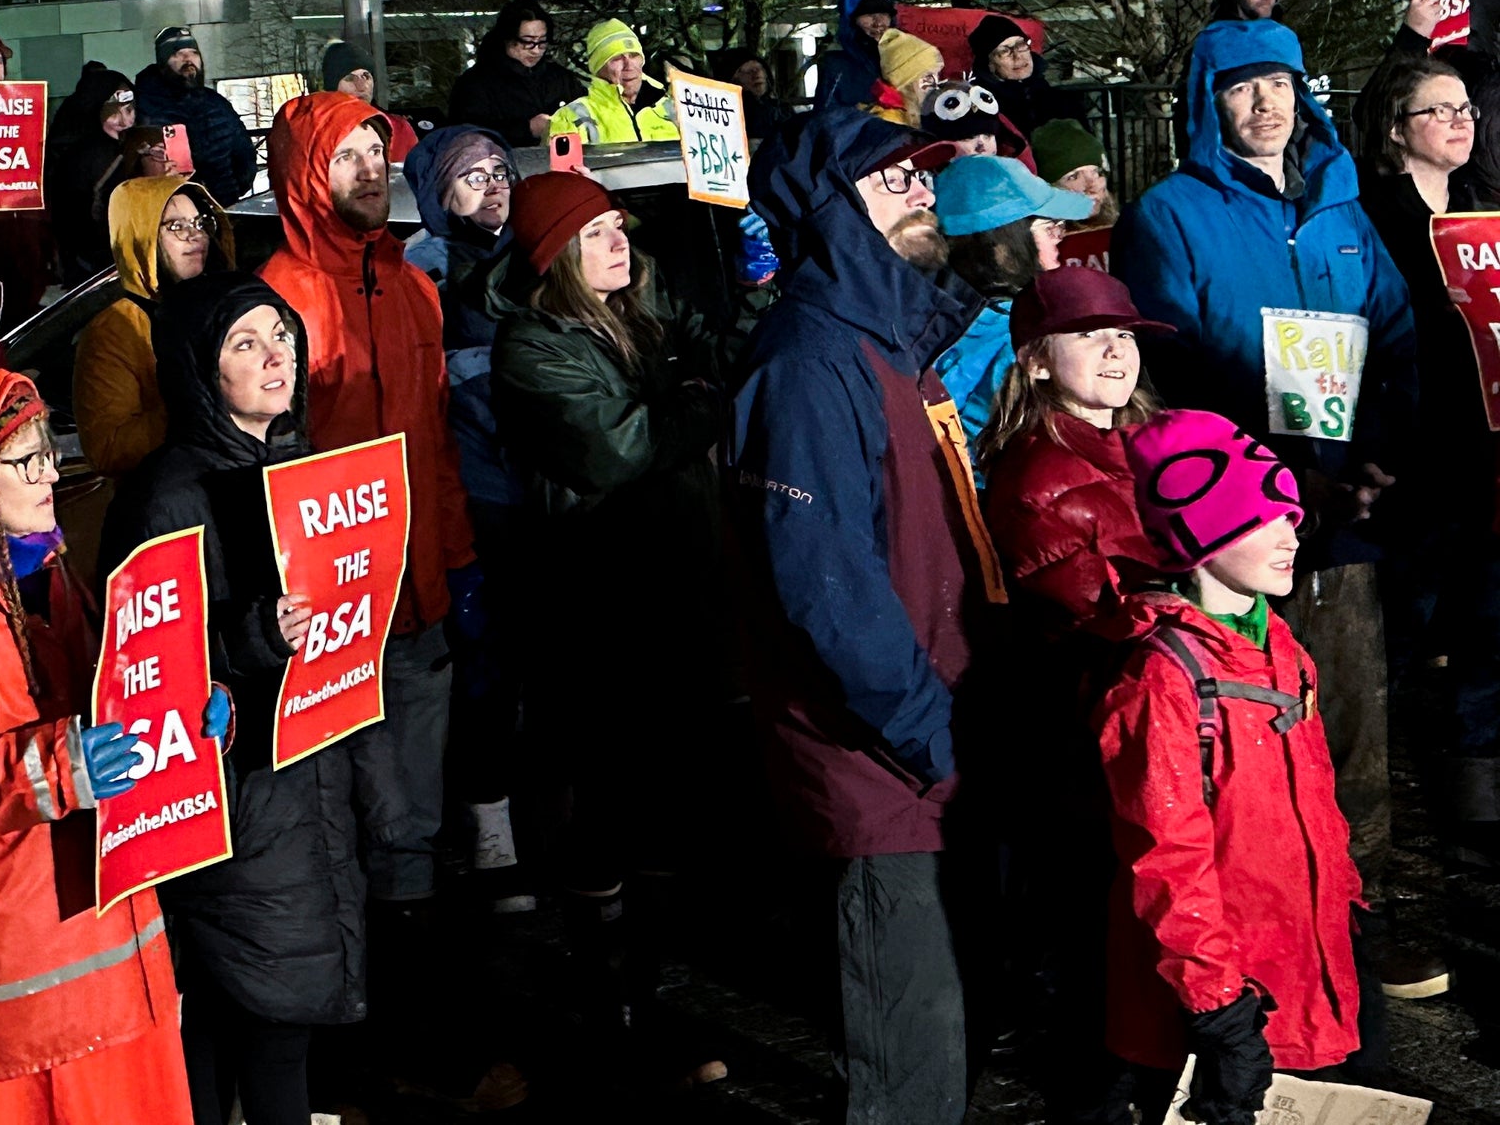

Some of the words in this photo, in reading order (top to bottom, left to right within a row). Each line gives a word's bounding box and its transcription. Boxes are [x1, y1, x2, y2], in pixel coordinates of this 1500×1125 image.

[696, 131, 736, 182] BSA
[1281, 391, 1350, 438] BS
[298, 478, 389, 539] RAISE
[333, 548, 371, 586] THE
[303, 593, 371, 664] BSA
[123, 655, 162, 700] THE
[109, 708, 198, 783] SA
